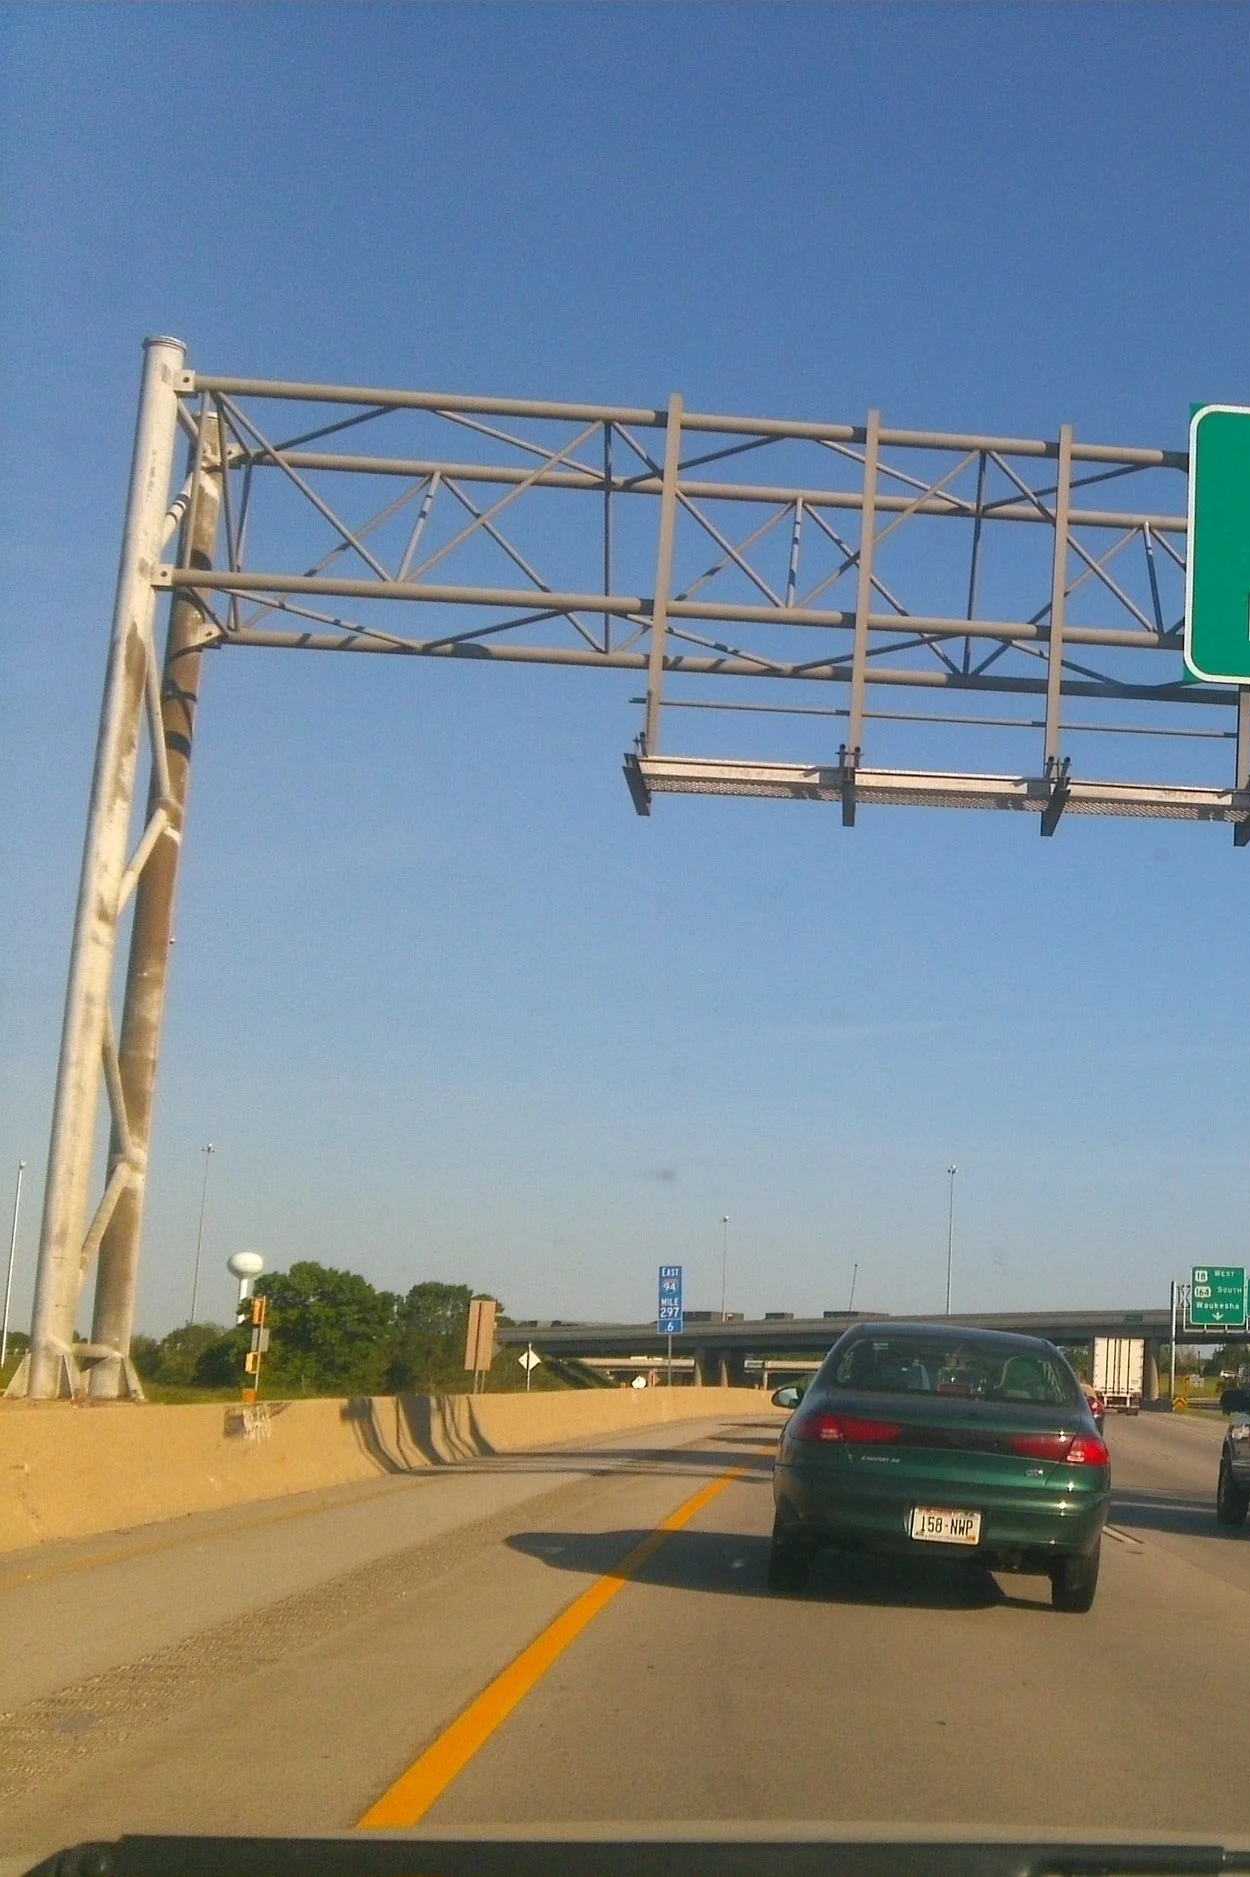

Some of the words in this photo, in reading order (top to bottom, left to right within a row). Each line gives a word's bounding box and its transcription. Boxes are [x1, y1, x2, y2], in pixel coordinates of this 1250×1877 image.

[662, 1267, 679, 1277] EAST
[1197, 1272, 1206, 1280] 18
[663, 1282, 676, 1291] 94
[1196, 1288, 1210, 1296] 164
[661, 1298, 679, 1306] MILE
[1196, 1301, 1240, 1310] Waukesha
[660, 1307, 680, 1318] 297
[664, 1321, 674, 1332] .6
[920, 1515, 974, 1537] 158-NWP
